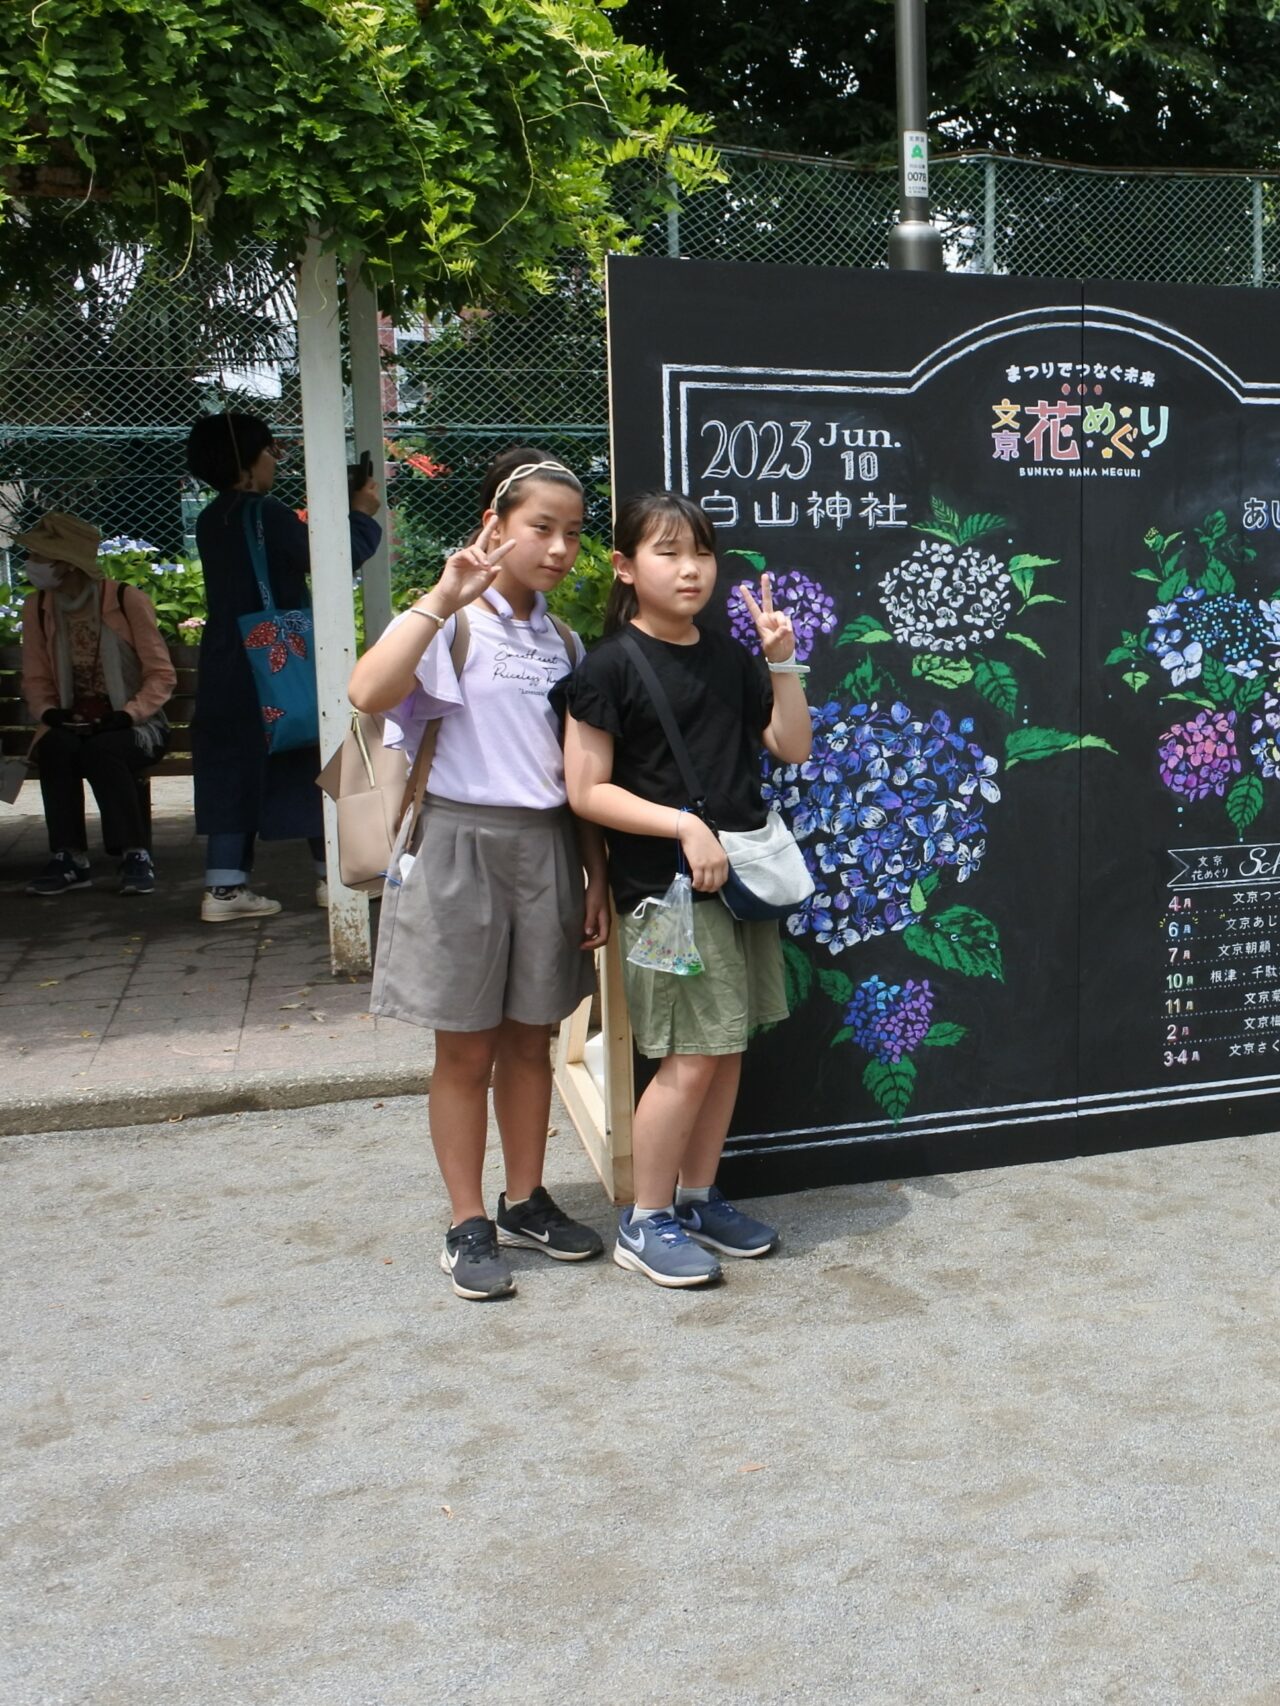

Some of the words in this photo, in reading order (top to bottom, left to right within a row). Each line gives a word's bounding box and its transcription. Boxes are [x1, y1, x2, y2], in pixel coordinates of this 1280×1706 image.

[1005, 361, 1156, 388] まつりでつなぐ未来
[991, 398, 1021, 461] 文京
[1023, 399, 1170, 461] 花めぐり
[700, 419, 812, 480] 2023
[819, 421, 902, 448] Jun.
[840, 451, 879, 481] 10
[1019, 467, 1064, 477] BUNKYO
[1069, 467, 1098, 477] HANA
[1101, 467, 1141, 478] MEGURI
[700, 489, 909, 531] 白山神社
[1191, 868, 1229, 880] 花めぐり
[1198, 855, 1224, 867] 文京
